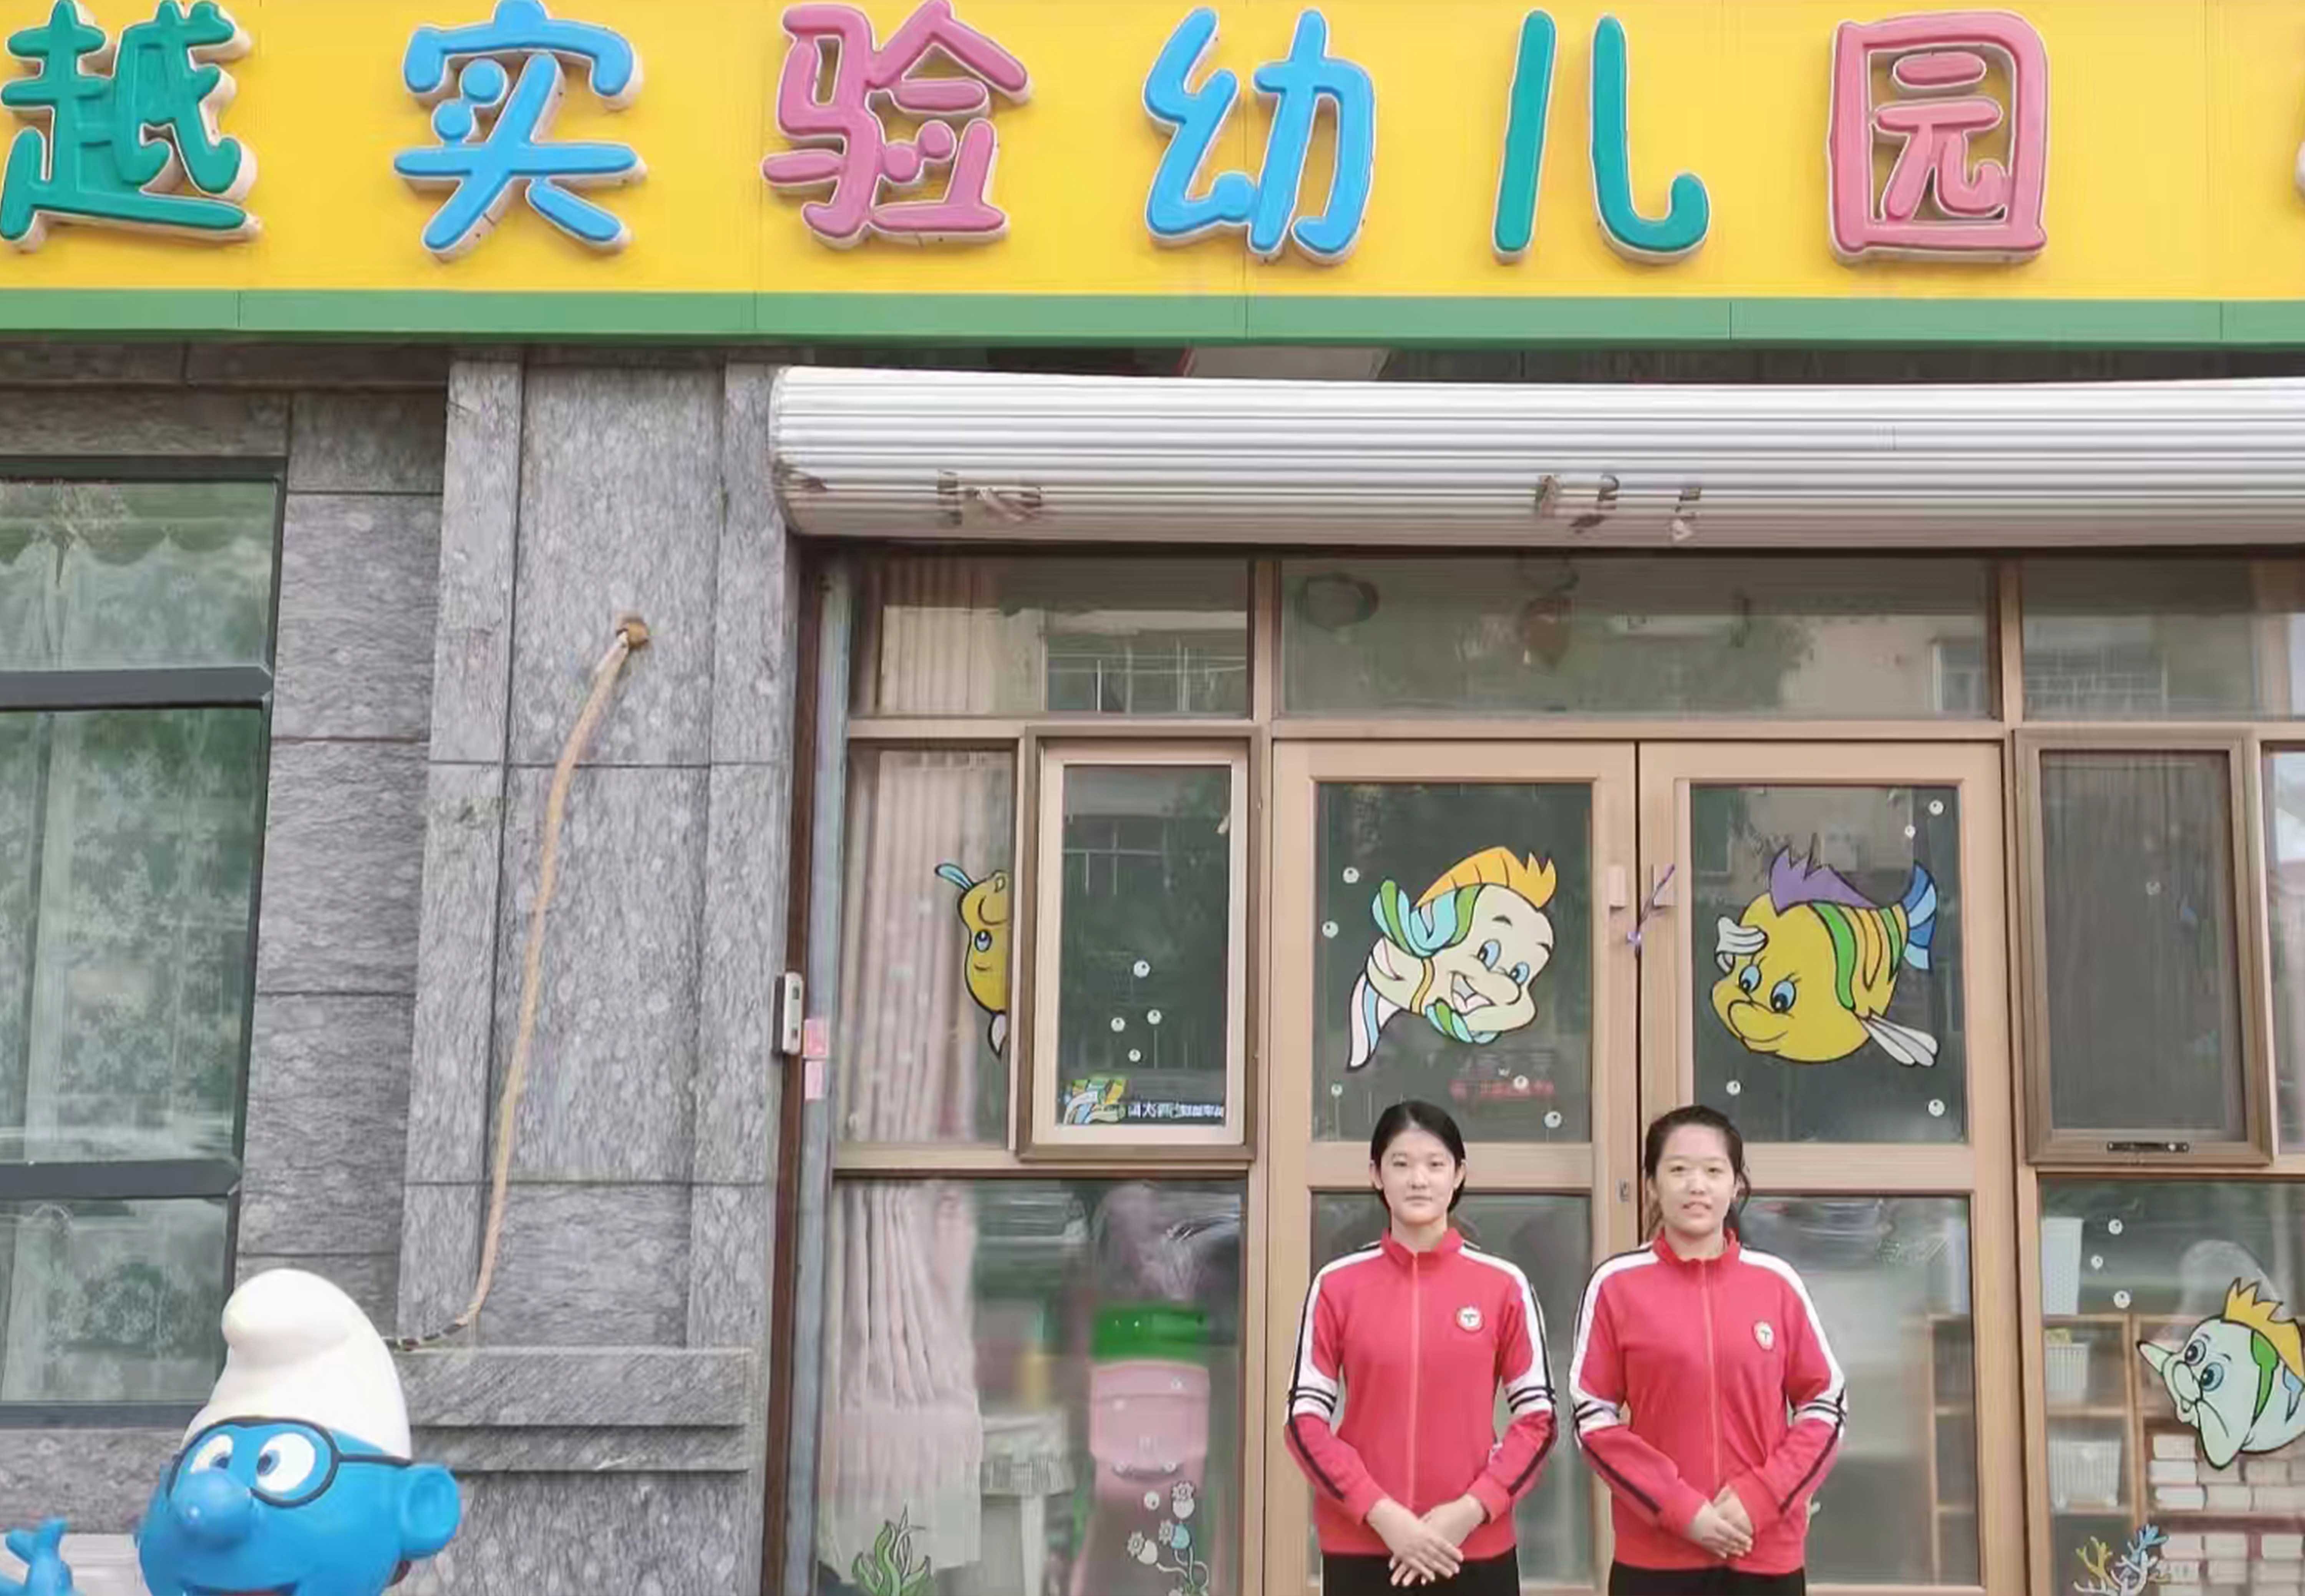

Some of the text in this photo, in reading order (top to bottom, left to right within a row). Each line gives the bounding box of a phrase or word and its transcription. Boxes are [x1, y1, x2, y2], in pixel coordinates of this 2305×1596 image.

[0, 0, 2048, 265] 越实验幼儿园
